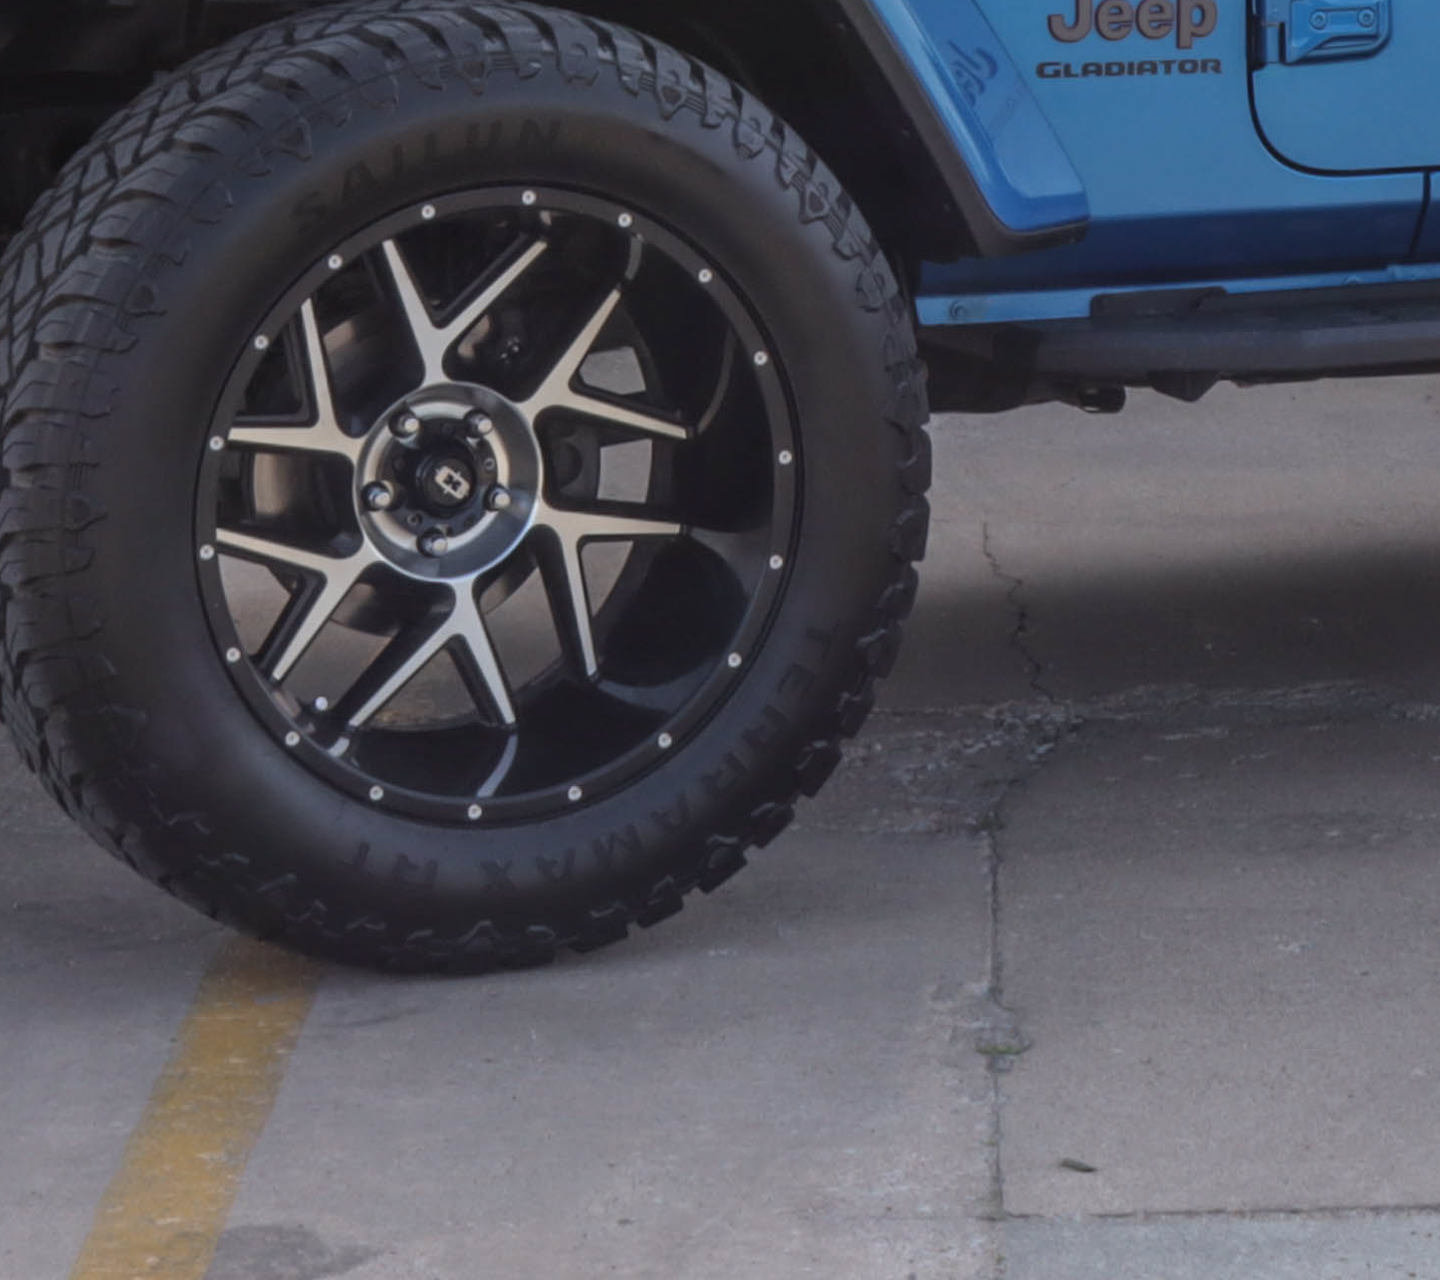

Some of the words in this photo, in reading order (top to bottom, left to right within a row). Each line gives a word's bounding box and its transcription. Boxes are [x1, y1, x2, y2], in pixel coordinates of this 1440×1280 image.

[1035, 58, 1222, 79] GLADIATOR
[290, 116, 565, 236] SAILUN
[478, 619, 844, 896] TERRAMAX
